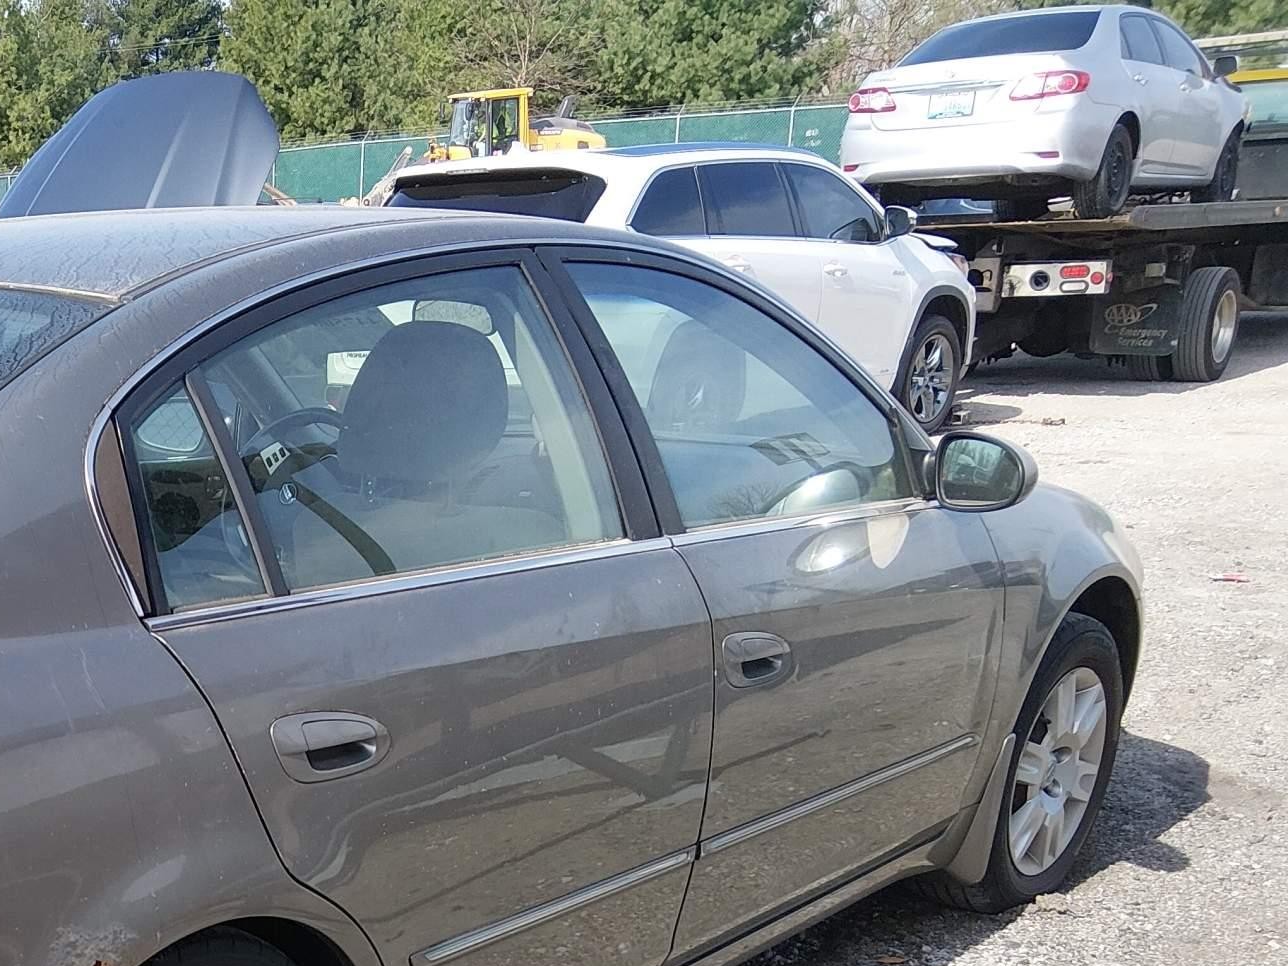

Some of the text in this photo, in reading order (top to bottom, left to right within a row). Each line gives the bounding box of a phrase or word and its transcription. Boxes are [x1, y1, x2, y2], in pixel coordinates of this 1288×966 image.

[1108, 304, 1137, 321] AAA
[1120, 327, 1168, 338] Emergency
[1118, 337, 1154, 346] Services
